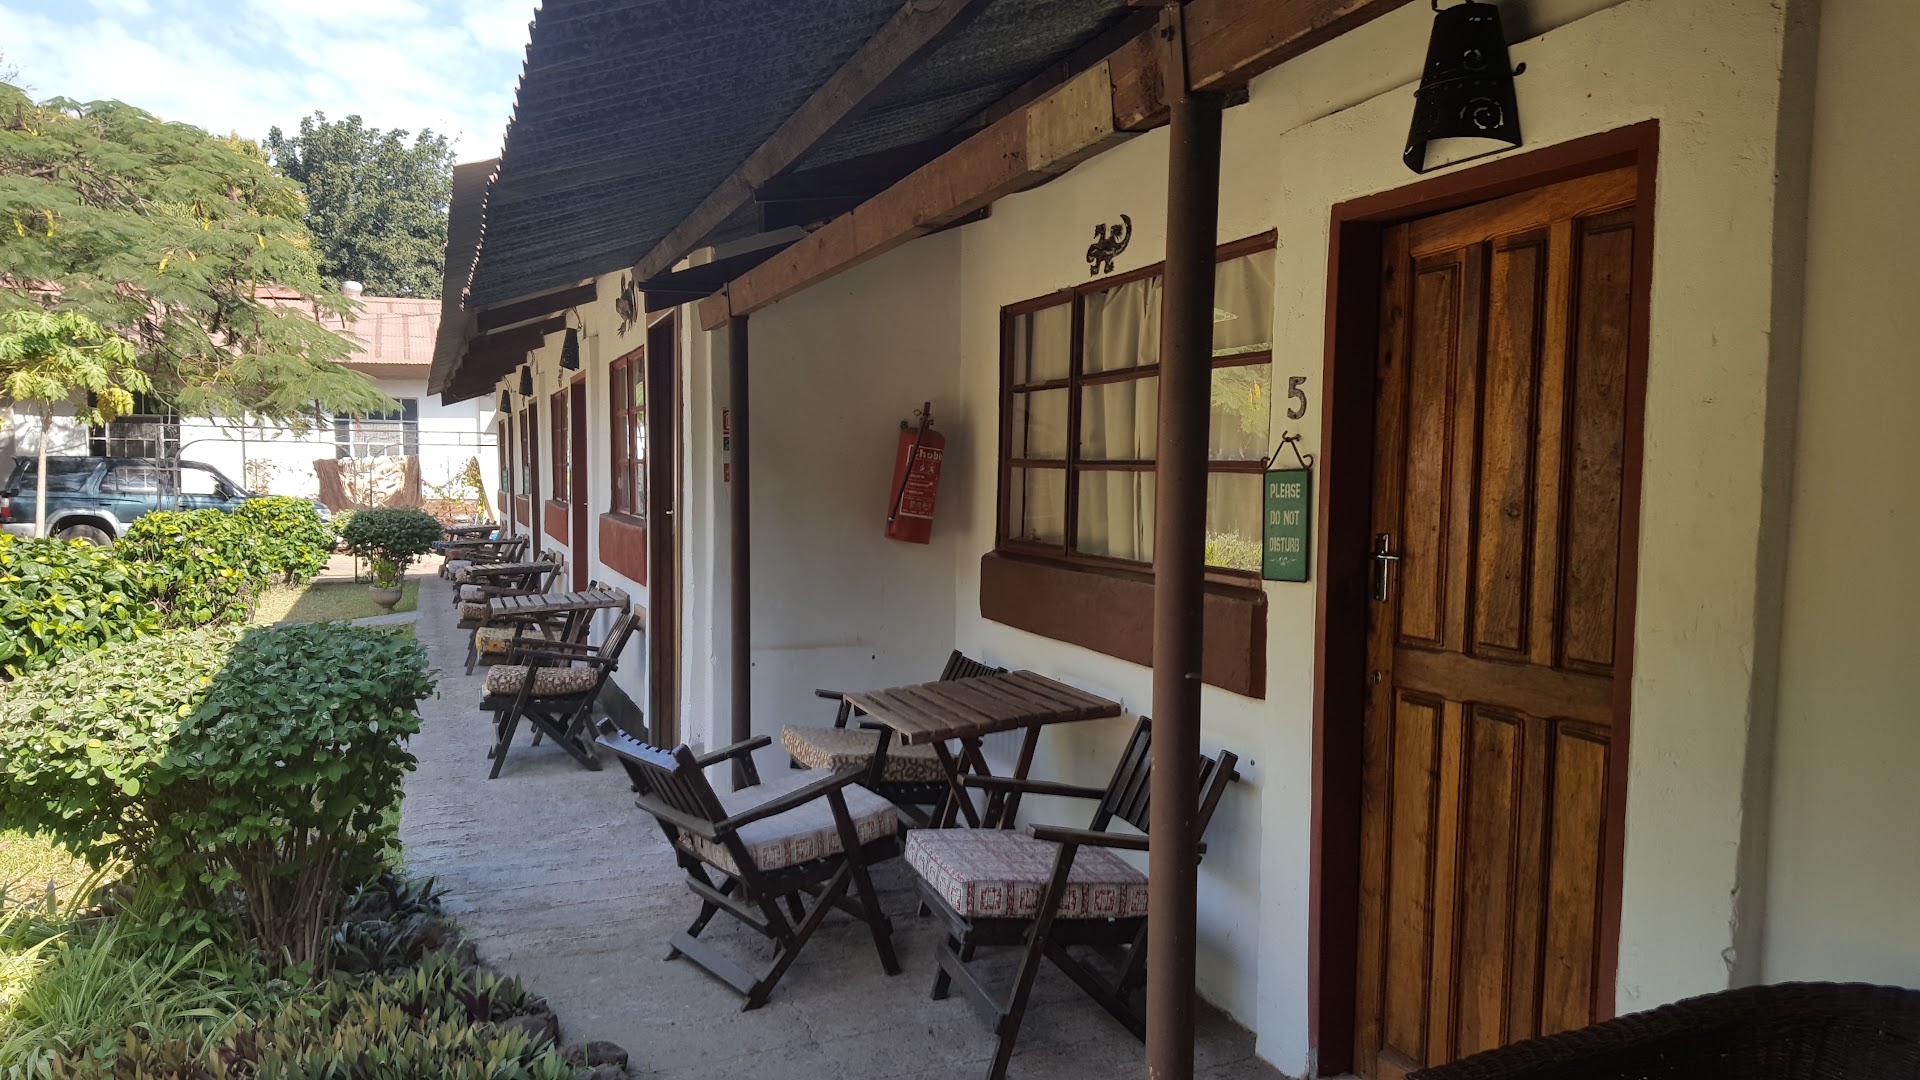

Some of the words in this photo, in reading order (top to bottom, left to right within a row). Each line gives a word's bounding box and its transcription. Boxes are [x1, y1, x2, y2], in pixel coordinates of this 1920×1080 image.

[1287, 376, 1307, 420] 5
[1270, 483, 1301, 498] PLEASE
[1270, 510, 1281, 525] DO
[1283, 510, 1300, 525] NOT
[1269, 536, 1300, 552] DISTURB
